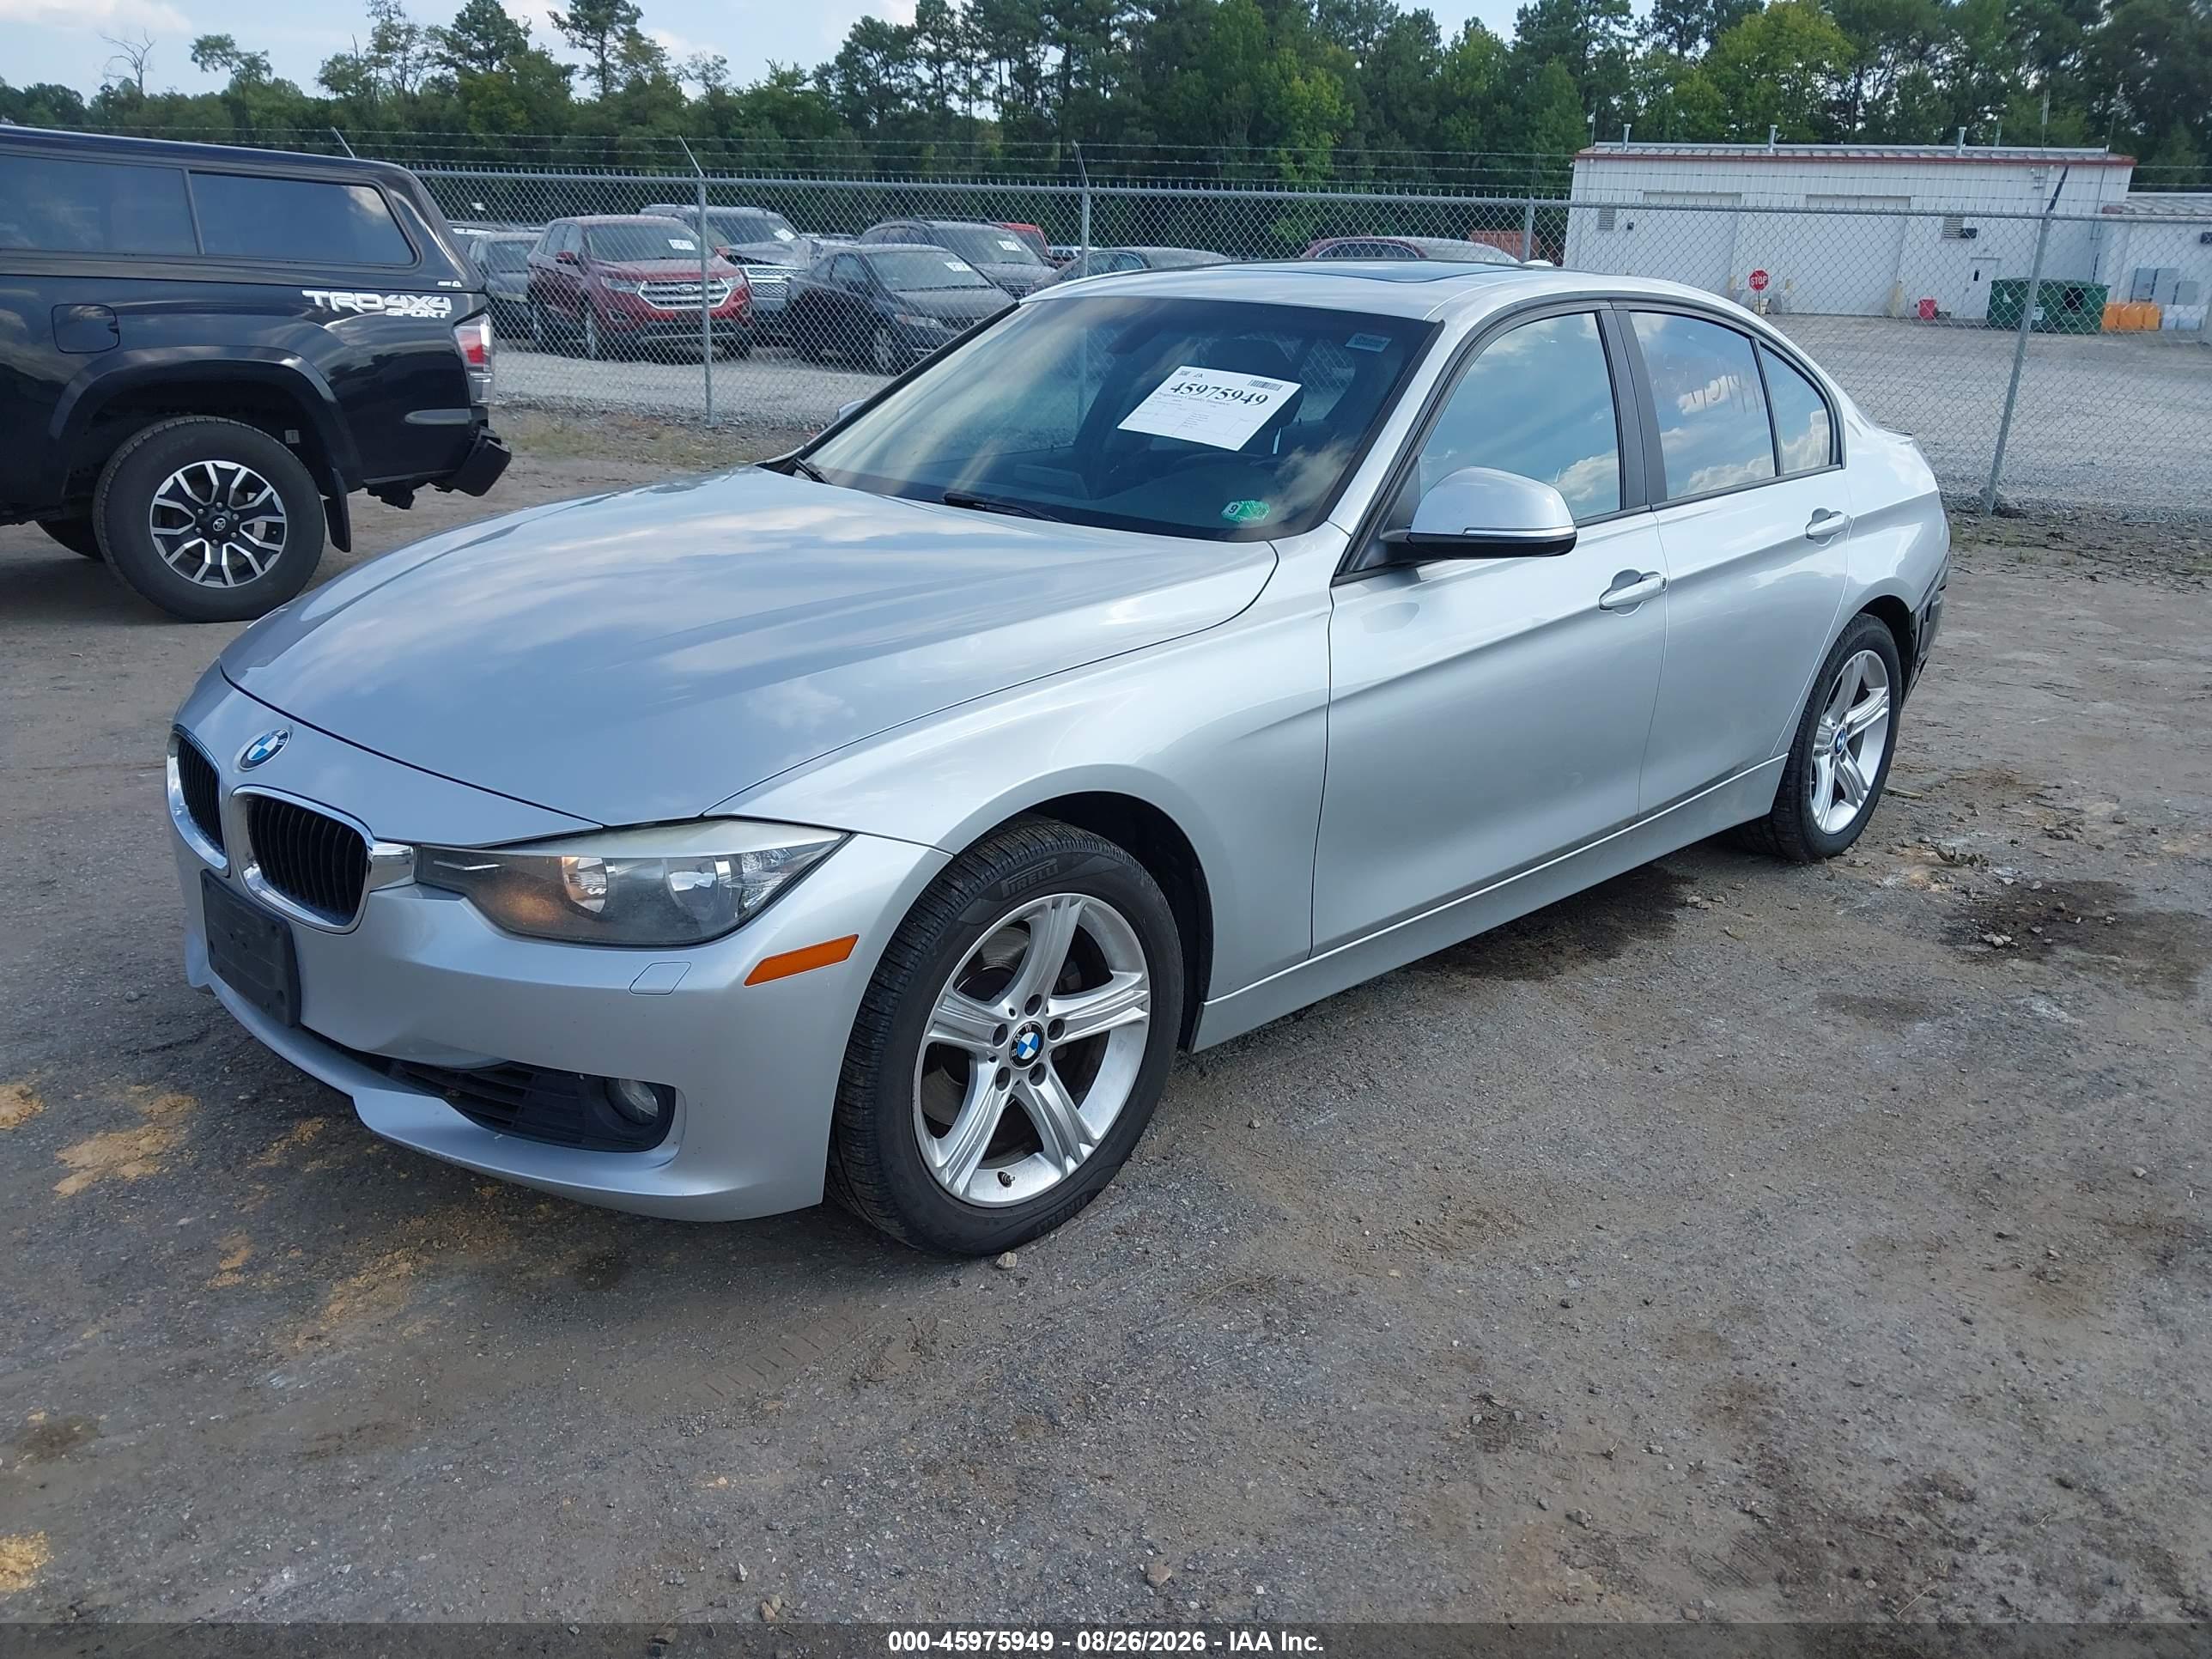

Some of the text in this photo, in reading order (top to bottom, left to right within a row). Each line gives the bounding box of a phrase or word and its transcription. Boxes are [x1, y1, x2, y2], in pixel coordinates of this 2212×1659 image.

[1750, 276, 1767, 286] STOP
[302, 289, 385, 313] TRD
[386, 308, 452, 319] SPORT
[1170, 381, 1268, 406] 45975949
[1000, 858, 1059, 898] PIRELLI
[1011, 1022, 1032, 1057] BMW
